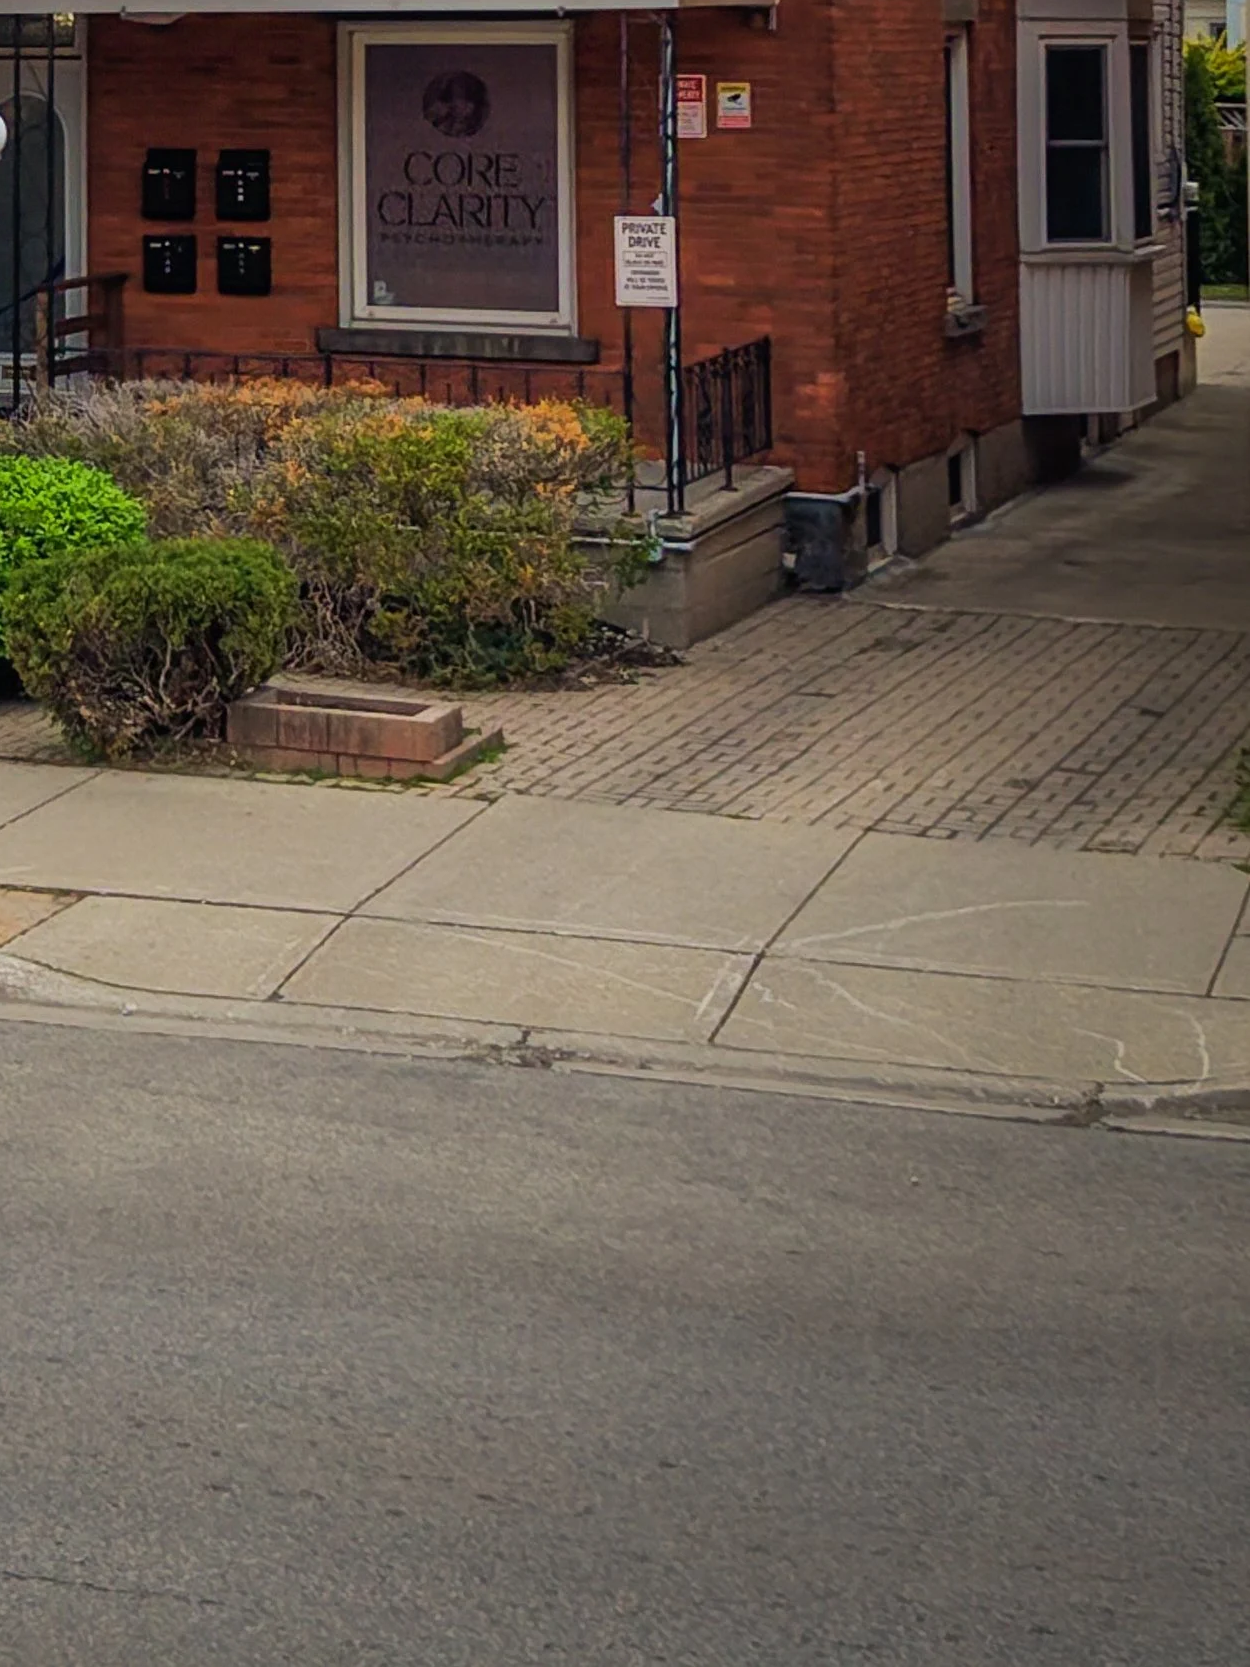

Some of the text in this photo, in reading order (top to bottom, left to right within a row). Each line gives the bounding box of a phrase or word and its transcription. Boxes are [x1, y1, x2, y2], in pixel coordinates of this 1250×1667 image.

[404, 151, 520, 188] CORE
[377, 191, 546, 229] CLARITY
[622, 222, 667, 235] PRIVATE
[629, 236, 661, 249] DRIVE
